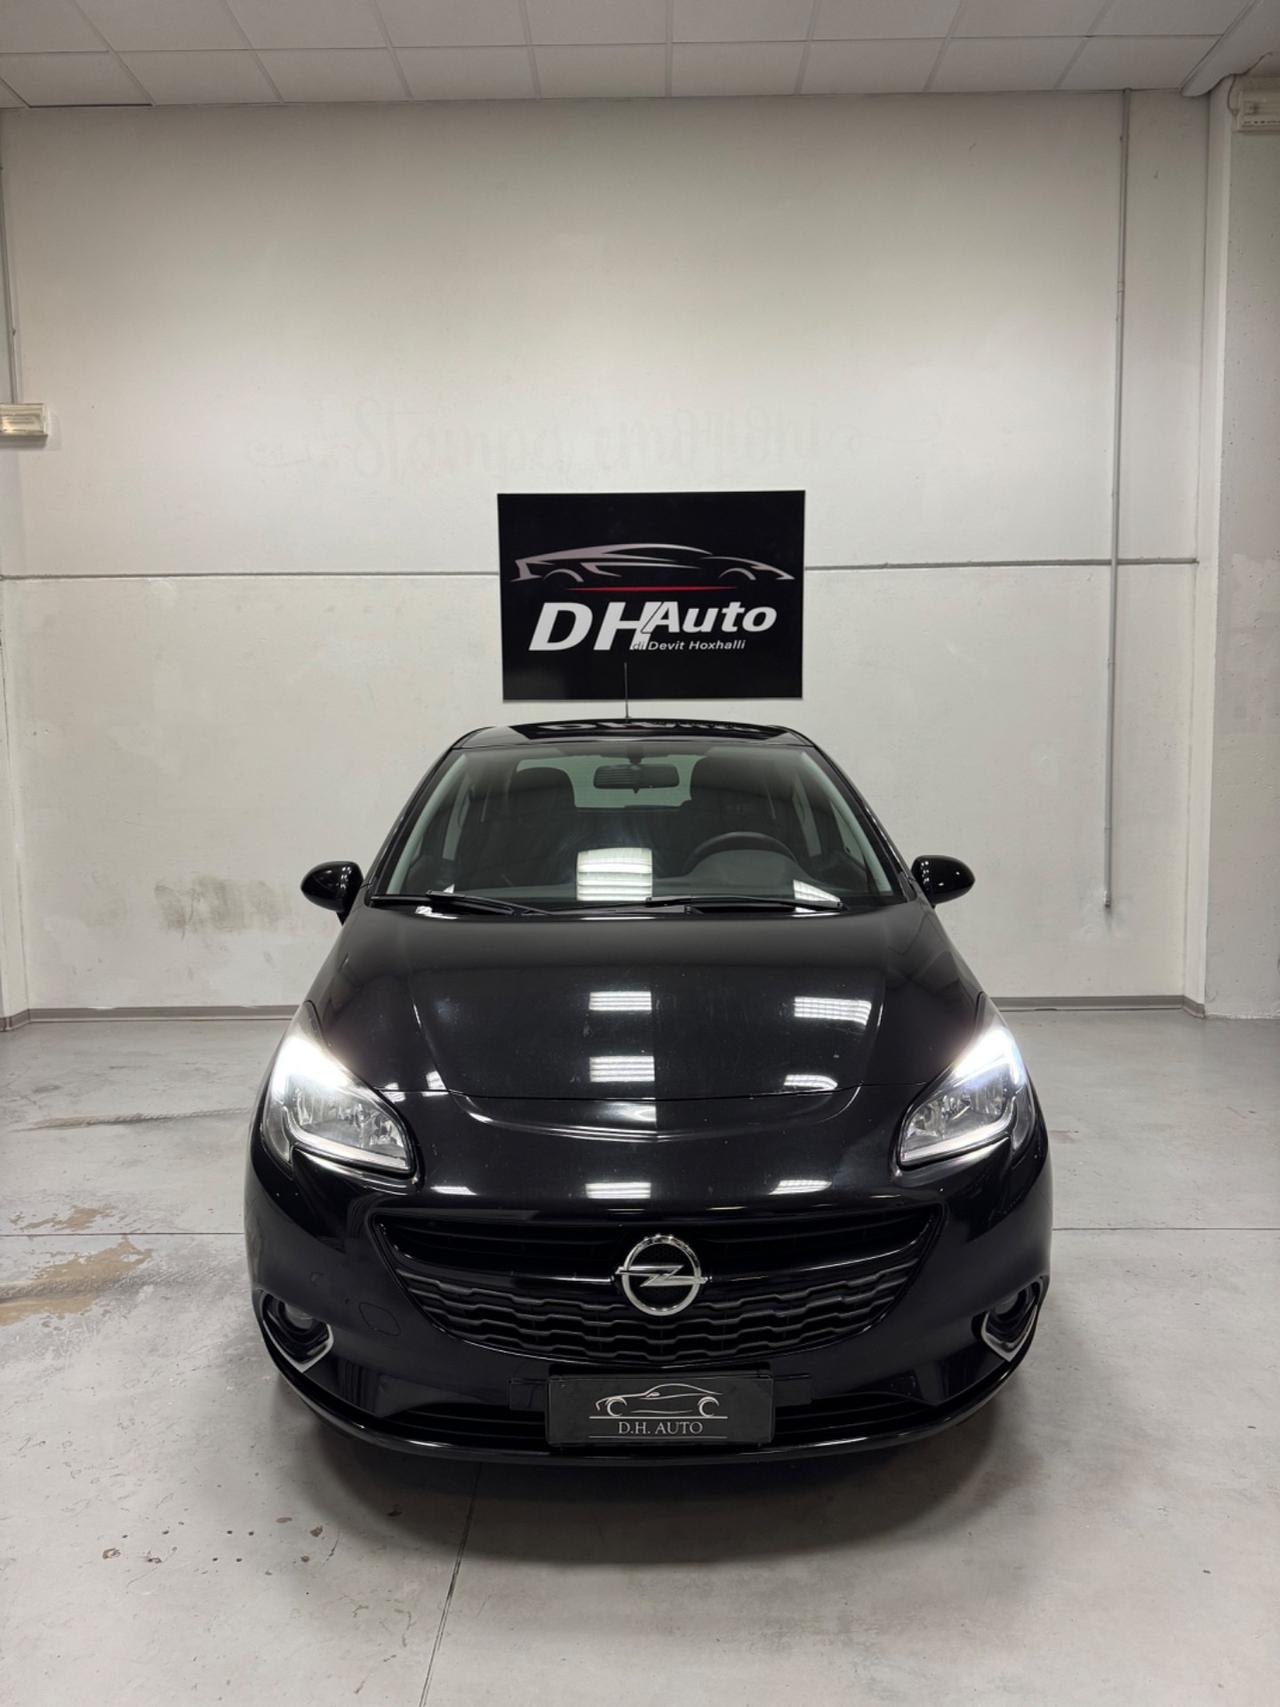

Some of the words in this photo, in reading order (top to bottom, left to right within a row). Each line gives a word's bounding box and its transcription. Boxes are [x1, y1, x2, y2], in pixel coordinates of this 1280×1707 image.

[648, 640, 685, 650] Devit
[688, 640, 746, 650] Hoxhalli
[618, 1421, 651, 1434] D.H.
[655, 1421, 703, 1434] AUTO
